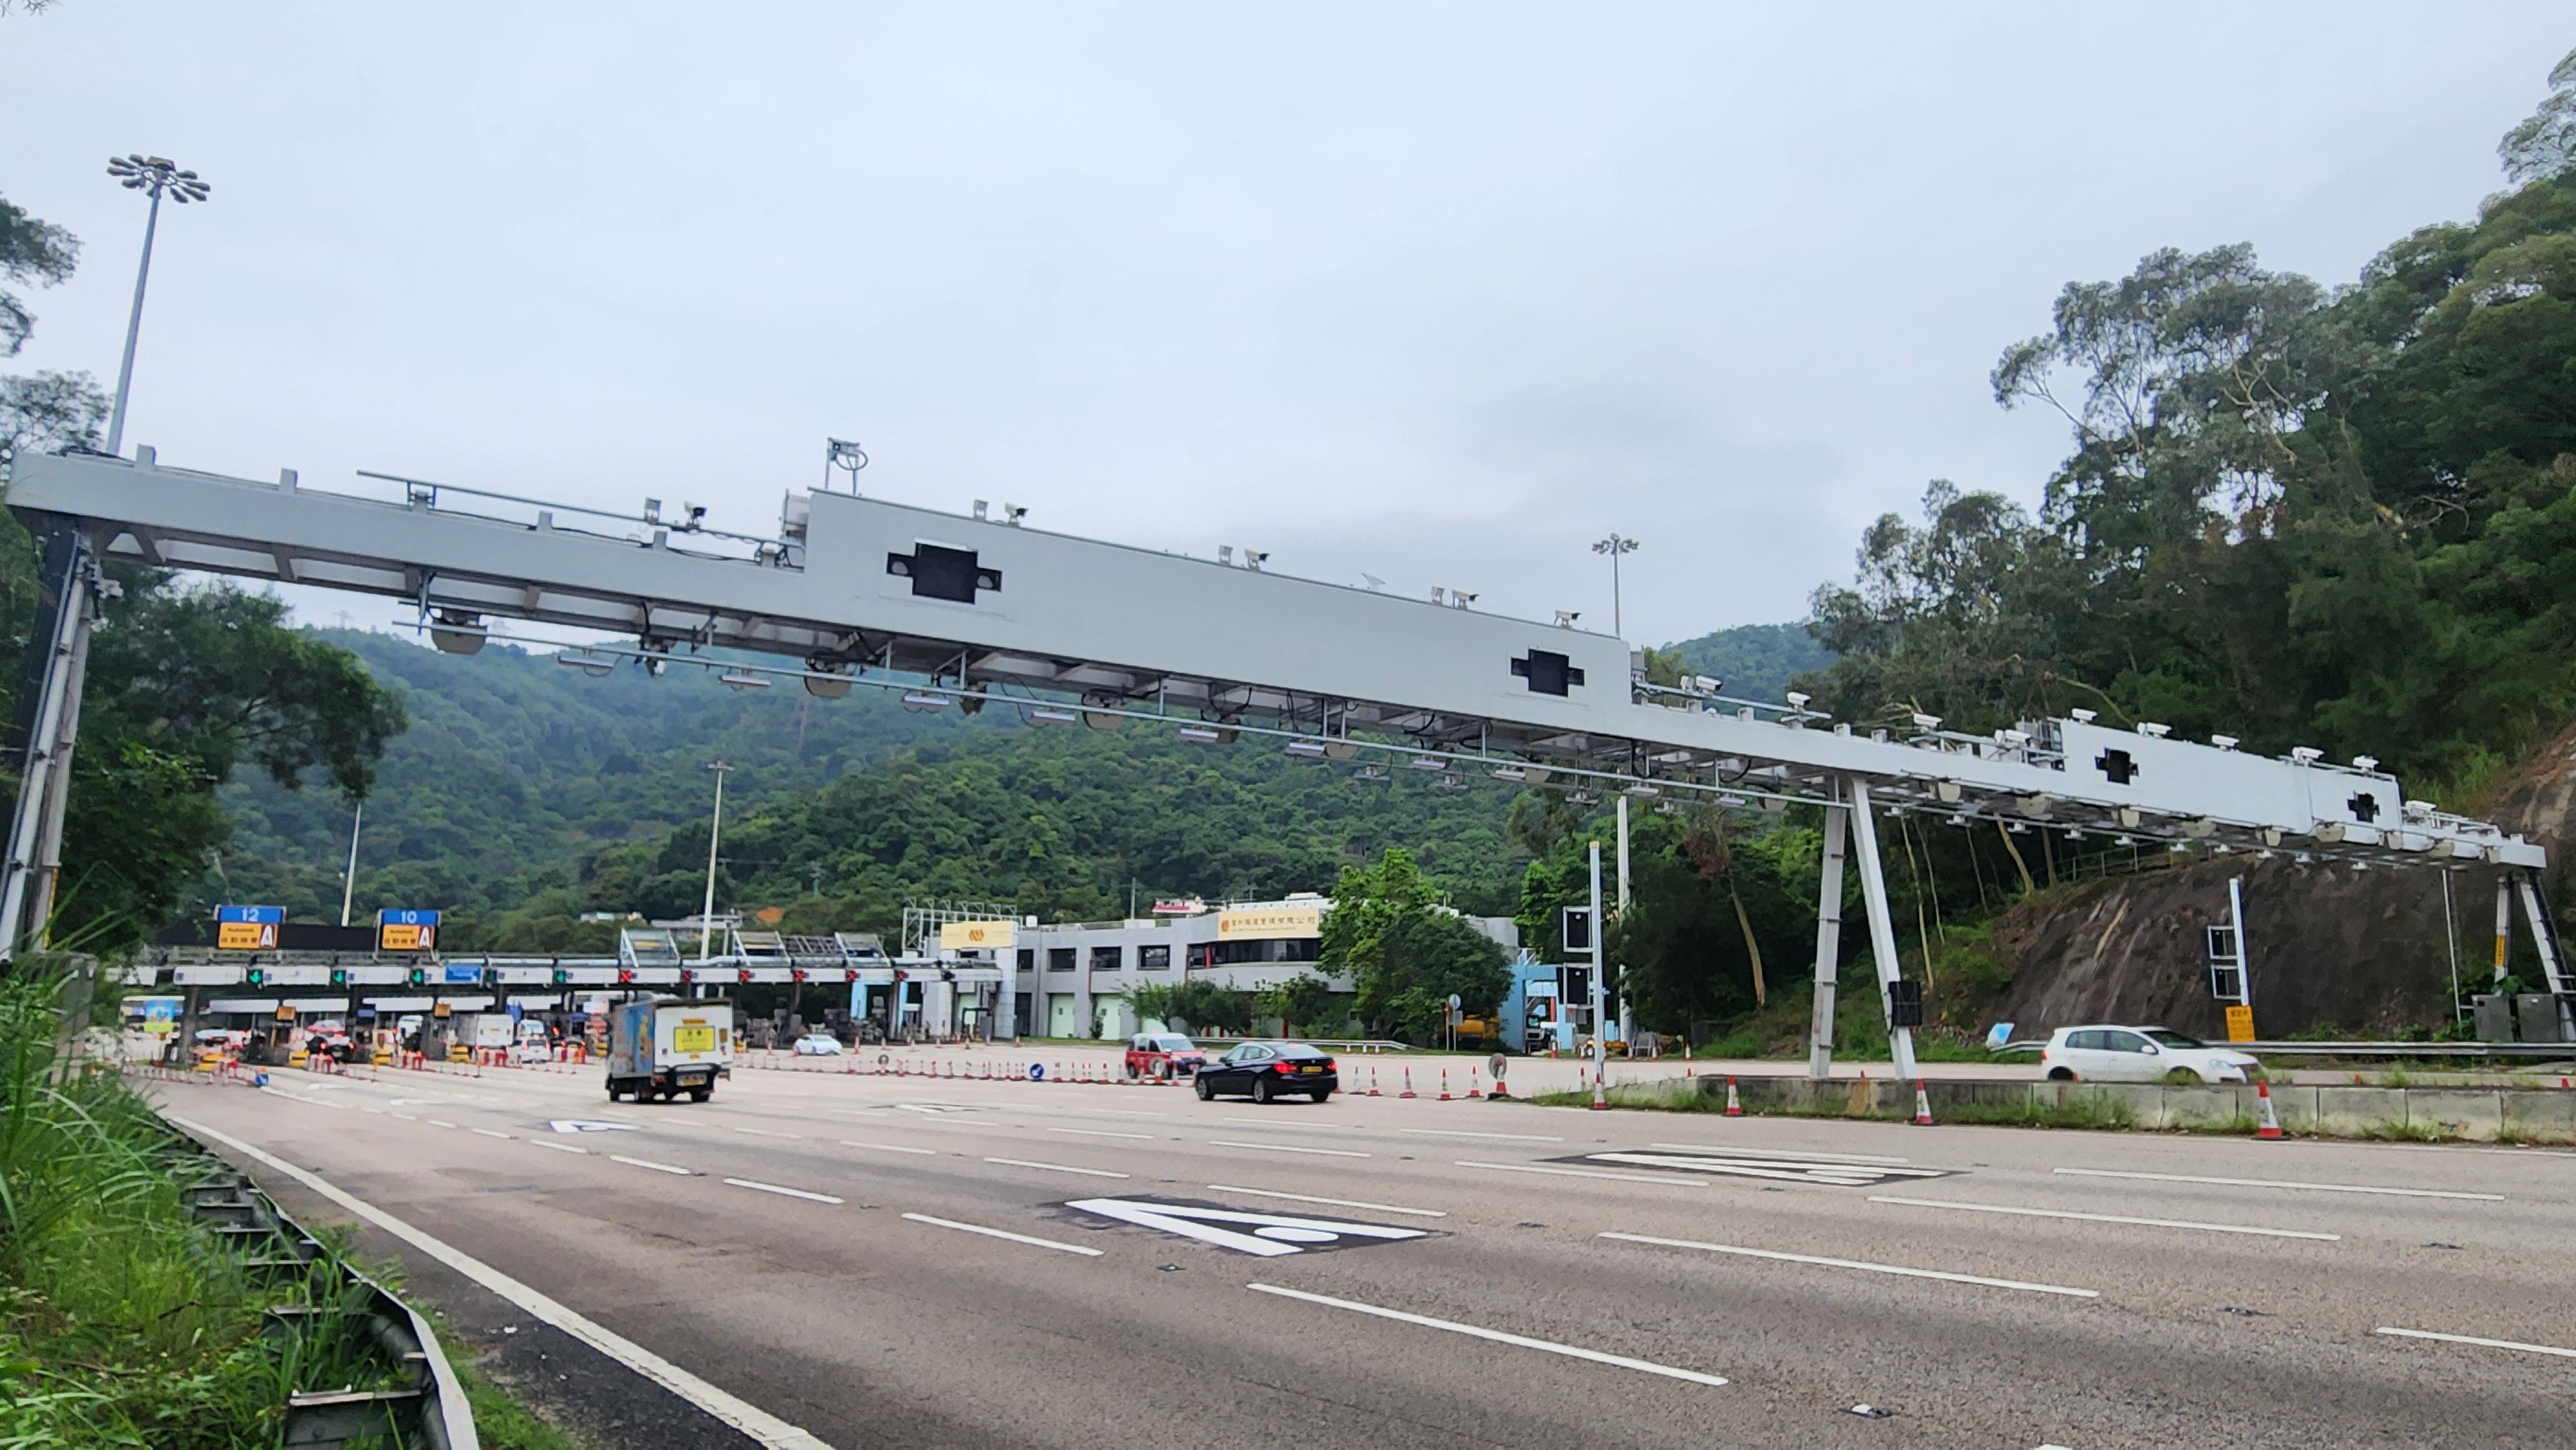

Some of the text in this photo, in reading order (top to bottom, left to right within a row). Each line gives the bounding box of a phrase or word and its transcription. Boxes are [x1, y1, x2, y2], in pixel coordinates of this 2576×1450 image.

[242, 908, 259, 921] 12
[401, 910, 417, 923] 10
[260, 925, 273, 947] A
[419, 926, 430, 948] A
